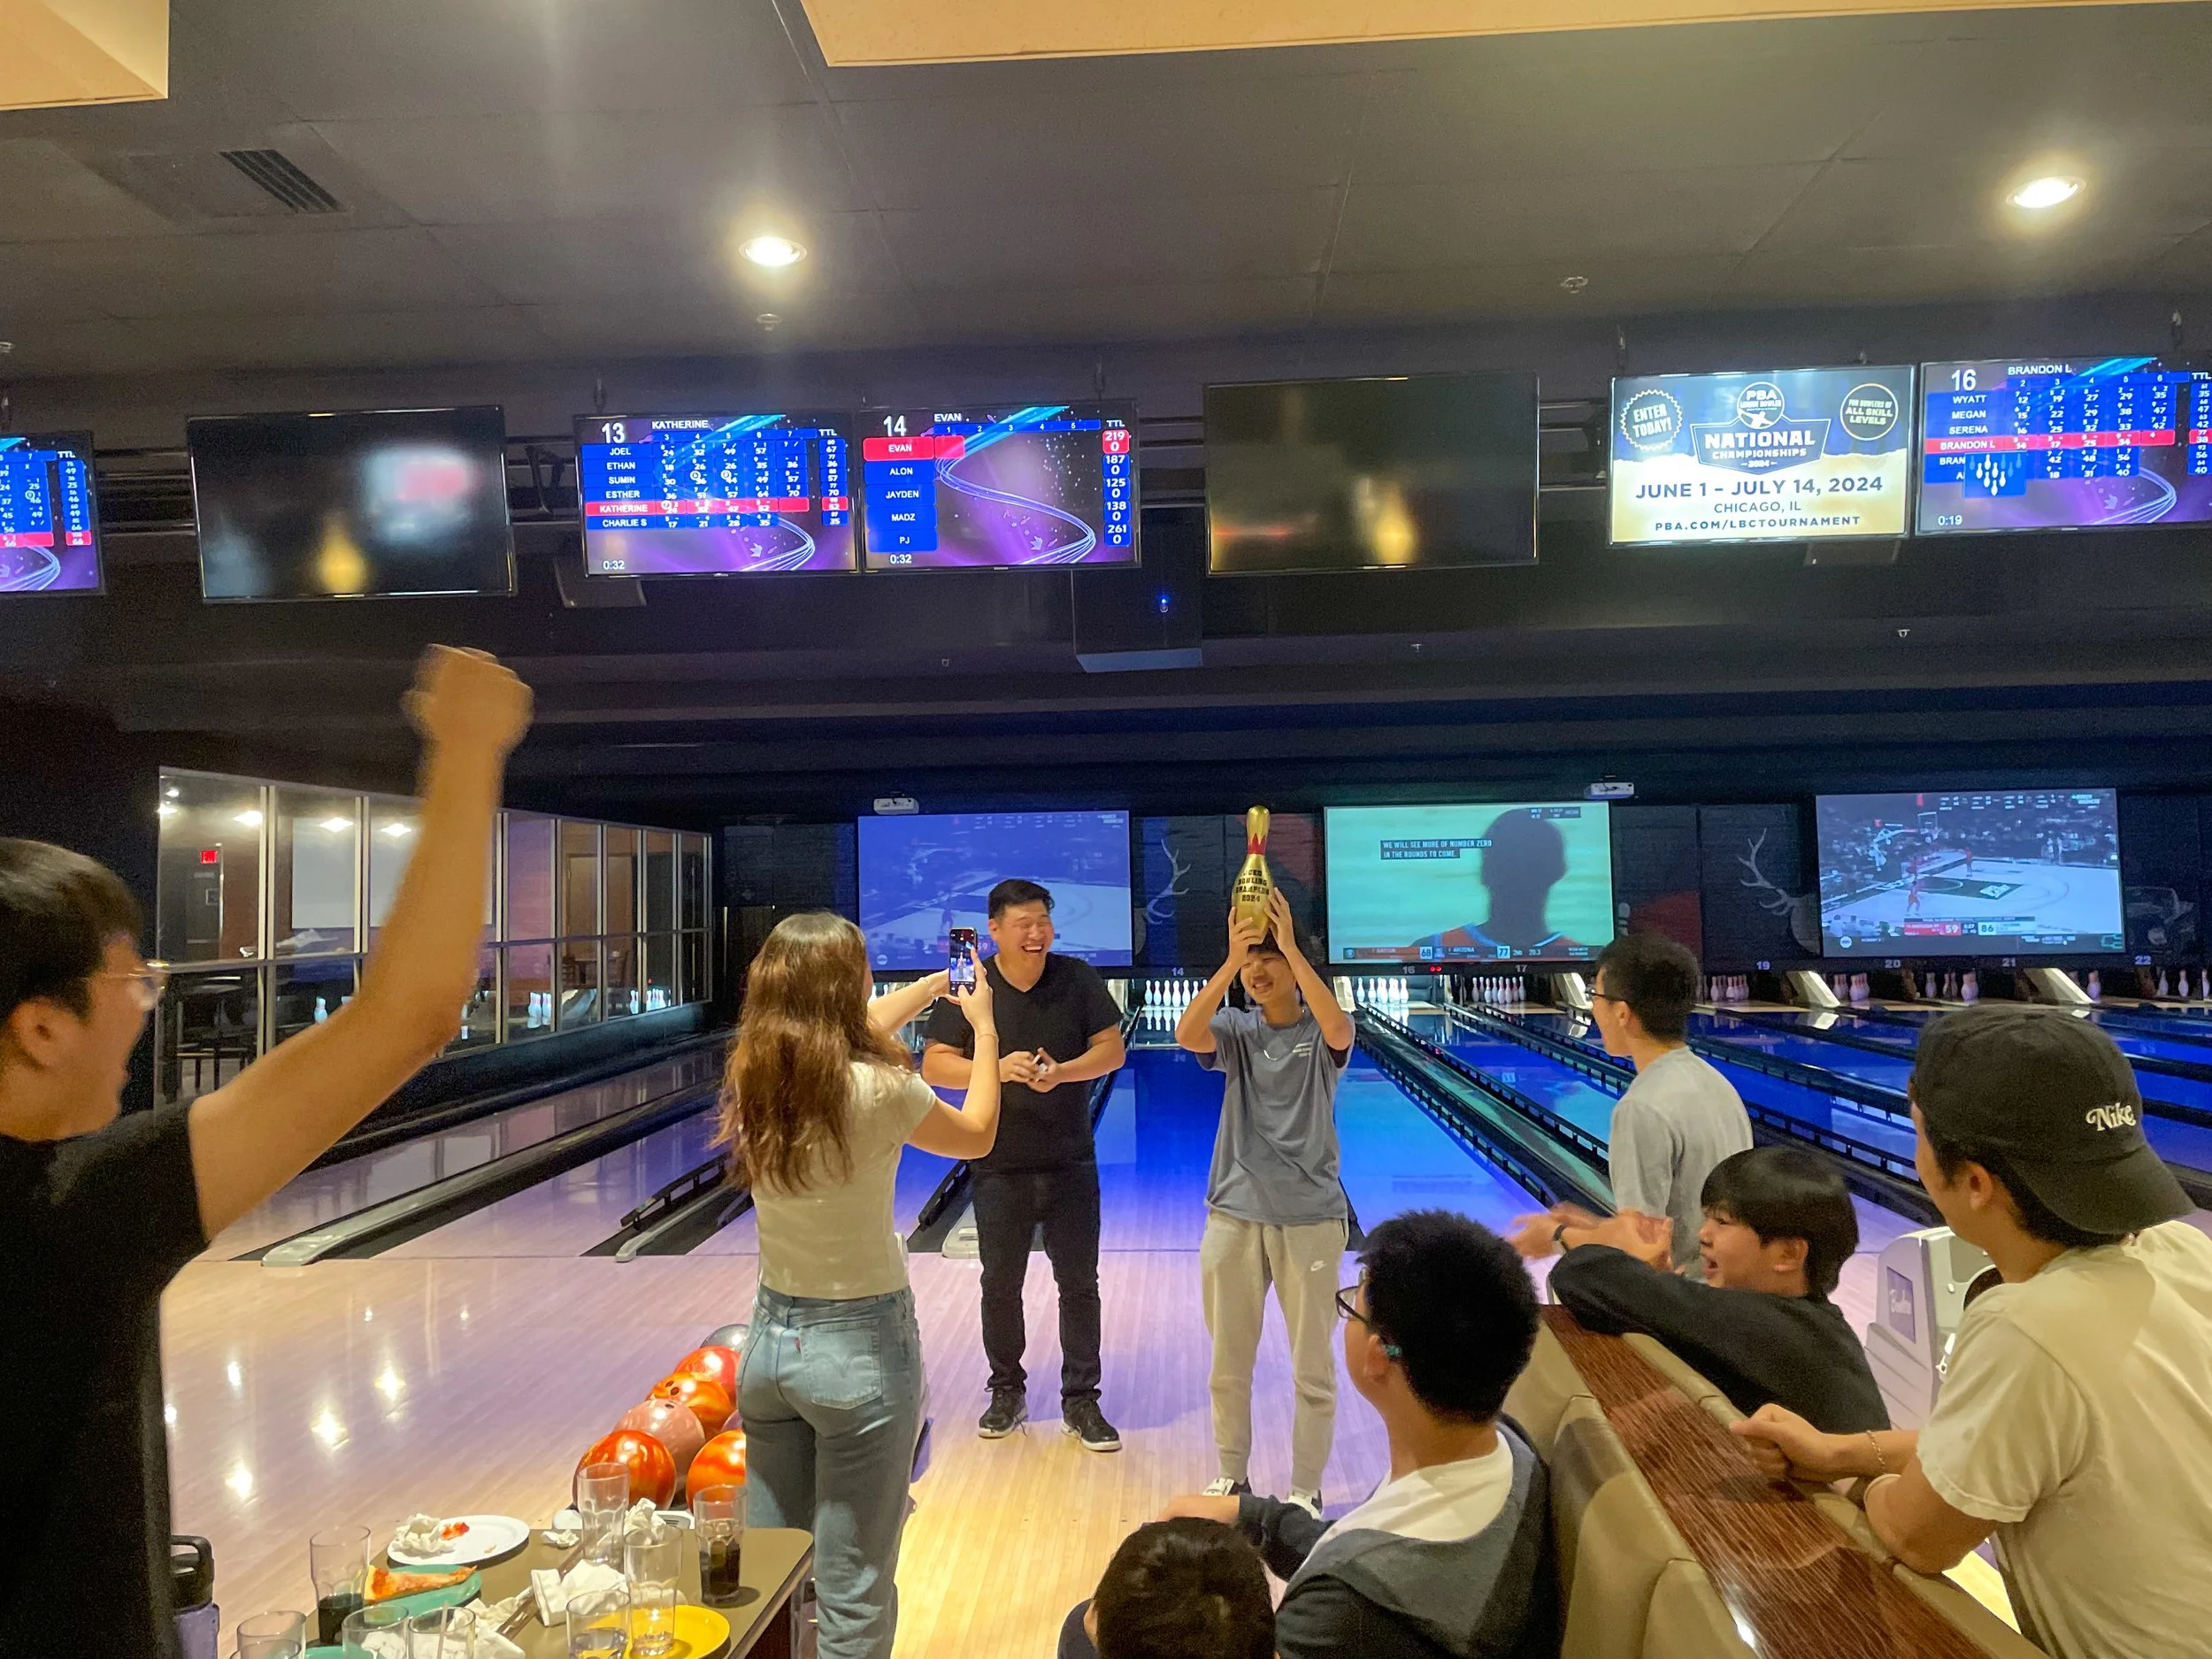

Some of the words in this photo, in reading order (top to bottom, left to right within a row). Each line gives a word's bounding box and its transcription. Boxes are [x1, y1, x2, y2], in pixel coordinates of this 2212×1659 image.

[2008, 365, 2062, 375] BRANDON
[2065, 365, 2072, 373] L
[1951, 370, 1976, 391] 16
[1747, 389, 1778, 401] PBA
[1953, 396, 1986, 404] WYATT
[1633, 403, 1666, 420] ENTER
[1865, 408, 1893, 417] SKILL
[1952, 411, 1986, 419] MEGAN
[934, 413, 962, 422] EVAN
[1849, 415, 1886, 425] LEVELS
[652, 420, 709, 429] KATHERINE
[884, 416, 907, 436] 14
[1632, 419, 1672, 437] TODAY!
[602, 422, 625, 443] 13
[1949, 426, 1988, 434] SERENA
[1105, 432, 1125, 441] 219
[1704, 430, 1816, 449] NATIONAL
[888, 444, 912, 453] EVAN
[1110, 442, 1119, 451] 0
[1940, 441, 1986, 450] BRANDON
[1989, 440, 1995, 449] L
[1712, 449, 1807, 460] CHAMPIONSHIPS
[1106, 455, 1125, 465] 187
[889, 467, 913, 476] ALON
[1111, 465, 1120, 475] 0
[609, 476, 636, 485] SUMIN
[1106, 479, 1125, 488] 125
[1636, 483, 1692, 499] JUNE
[1700, 482, 1707, 496] 1
[1732, 480, 1786, 495] JULY
[1793, 480, 1821, 495] 14,
[1829, 476, 1883, 492] 2024
[605, 490, 641, 499] ESTHER
[886, 489, 919, 499] JAYDEN
[1111, 489, 1120, 498] 0
[600, 503, 648, 513] KATHERINE
[1107, 502, 1126, 511] 138
[1714, 502, 1785, 513] CHICAGO,
[1790, 502, 1801, 511] IL
[891, 513, 916, 522] MADZ
[1112, 511, 1121, 521] 0
[1938, 516, 1962, 526] 0:19
[603, 518, 639, 527] CHARLIE
[640, 518, 647, 527] S
[1655, 516, 1861, 531] PBA.COM/LBCTOURNAMENT
[1108, 525, 1127, 534] 261
[899, 536, 910, 545] PJ
[1112, 534, 1122, 544] 0
[890, 554, 911, 564] 0:32
[603, 561, 625, 571] 0:32
[1946, 925, 1959, 933] 59
[1499, 948, 1509, 956] 77
[1885, 959, 1901, 969] 20
[2001, 957, 2016, 967] 21
[2134, 956, 2152, 964] 22
[1402, 965, 1416, 974] 16
[1756, 961, 1770, 970] 19
[1171, 967, 1184, 976] 14
[2085, 1102, 2137, 1132] Nike
